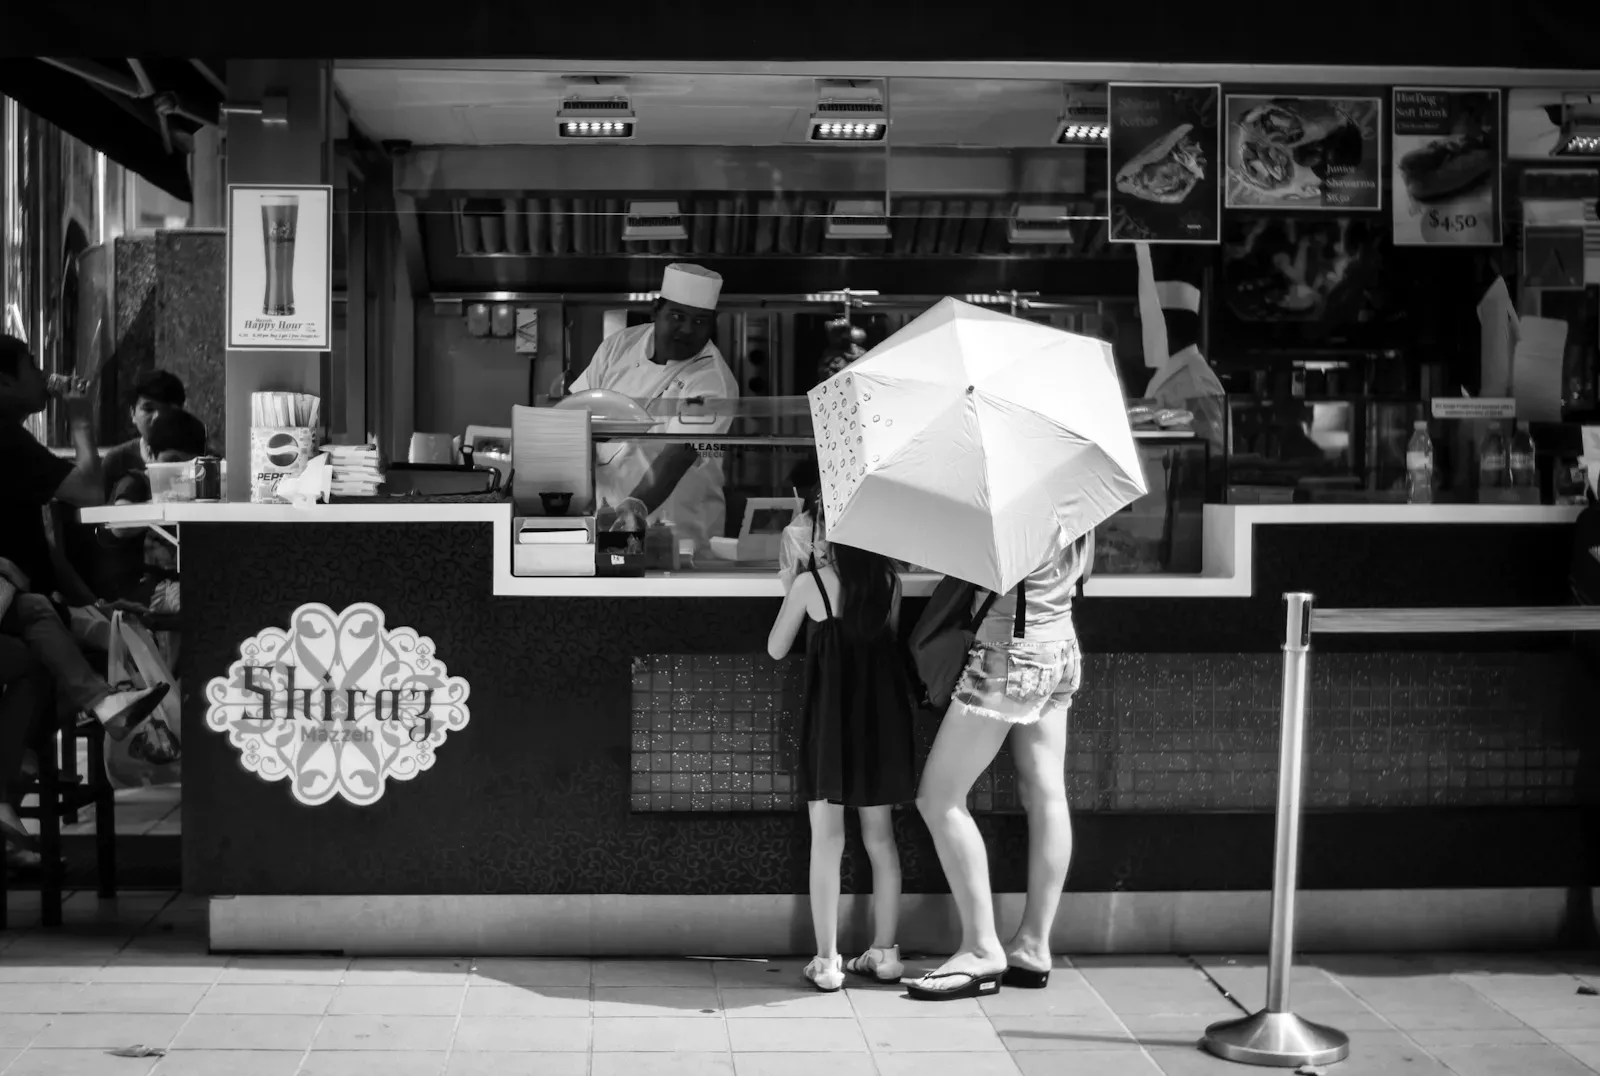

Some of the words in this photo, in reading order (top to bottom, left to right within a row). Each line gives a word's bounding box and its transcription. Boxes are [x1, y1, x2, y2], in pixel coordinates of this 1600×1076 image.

[1428, 208, 1477, 232] $4.50
[244, 320, 276, 331] Happy
[278, 320, 303, 330] Hour
[684, 443, 727, 452] PLEASE
[241, 665, 434, 742] Shiraz
[301, 727, 374, 742] Mazzeh
